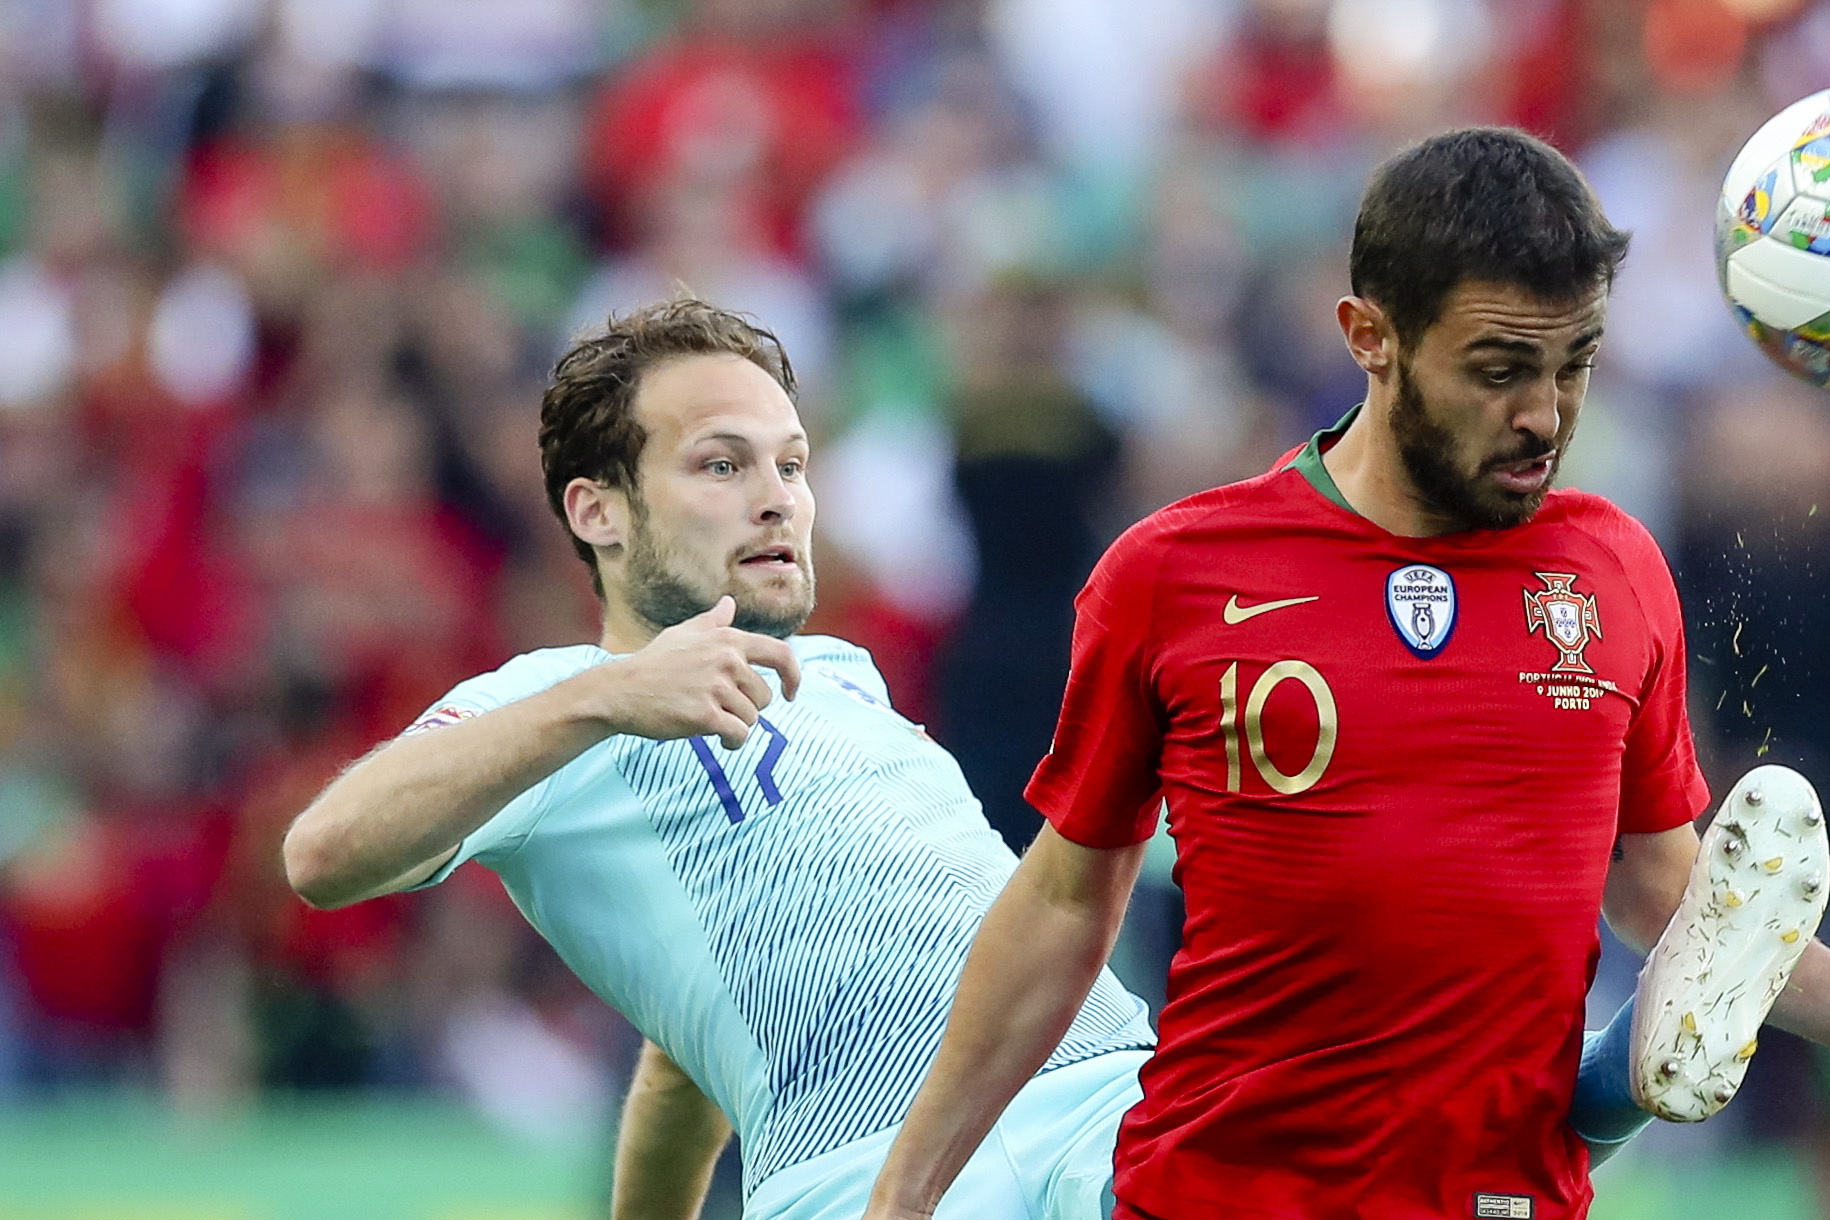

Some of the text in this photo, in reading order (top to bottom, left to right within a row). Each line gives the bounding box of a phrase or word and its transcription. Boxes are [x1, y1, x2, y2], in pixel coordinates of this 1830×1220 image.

[1405, 569, 1434, 582] UEFA
[1393, 585, 1448, 594] EUROPEAN
[1394, 594, 1448, 602] CHAMPIONS
[1537, 685, 1544, 695] 9
[1546, 685, 1580, 697] JUNHO
[1554, 698, 1590, 710] PORTO
[1219, 660, 1338, 795] 10
